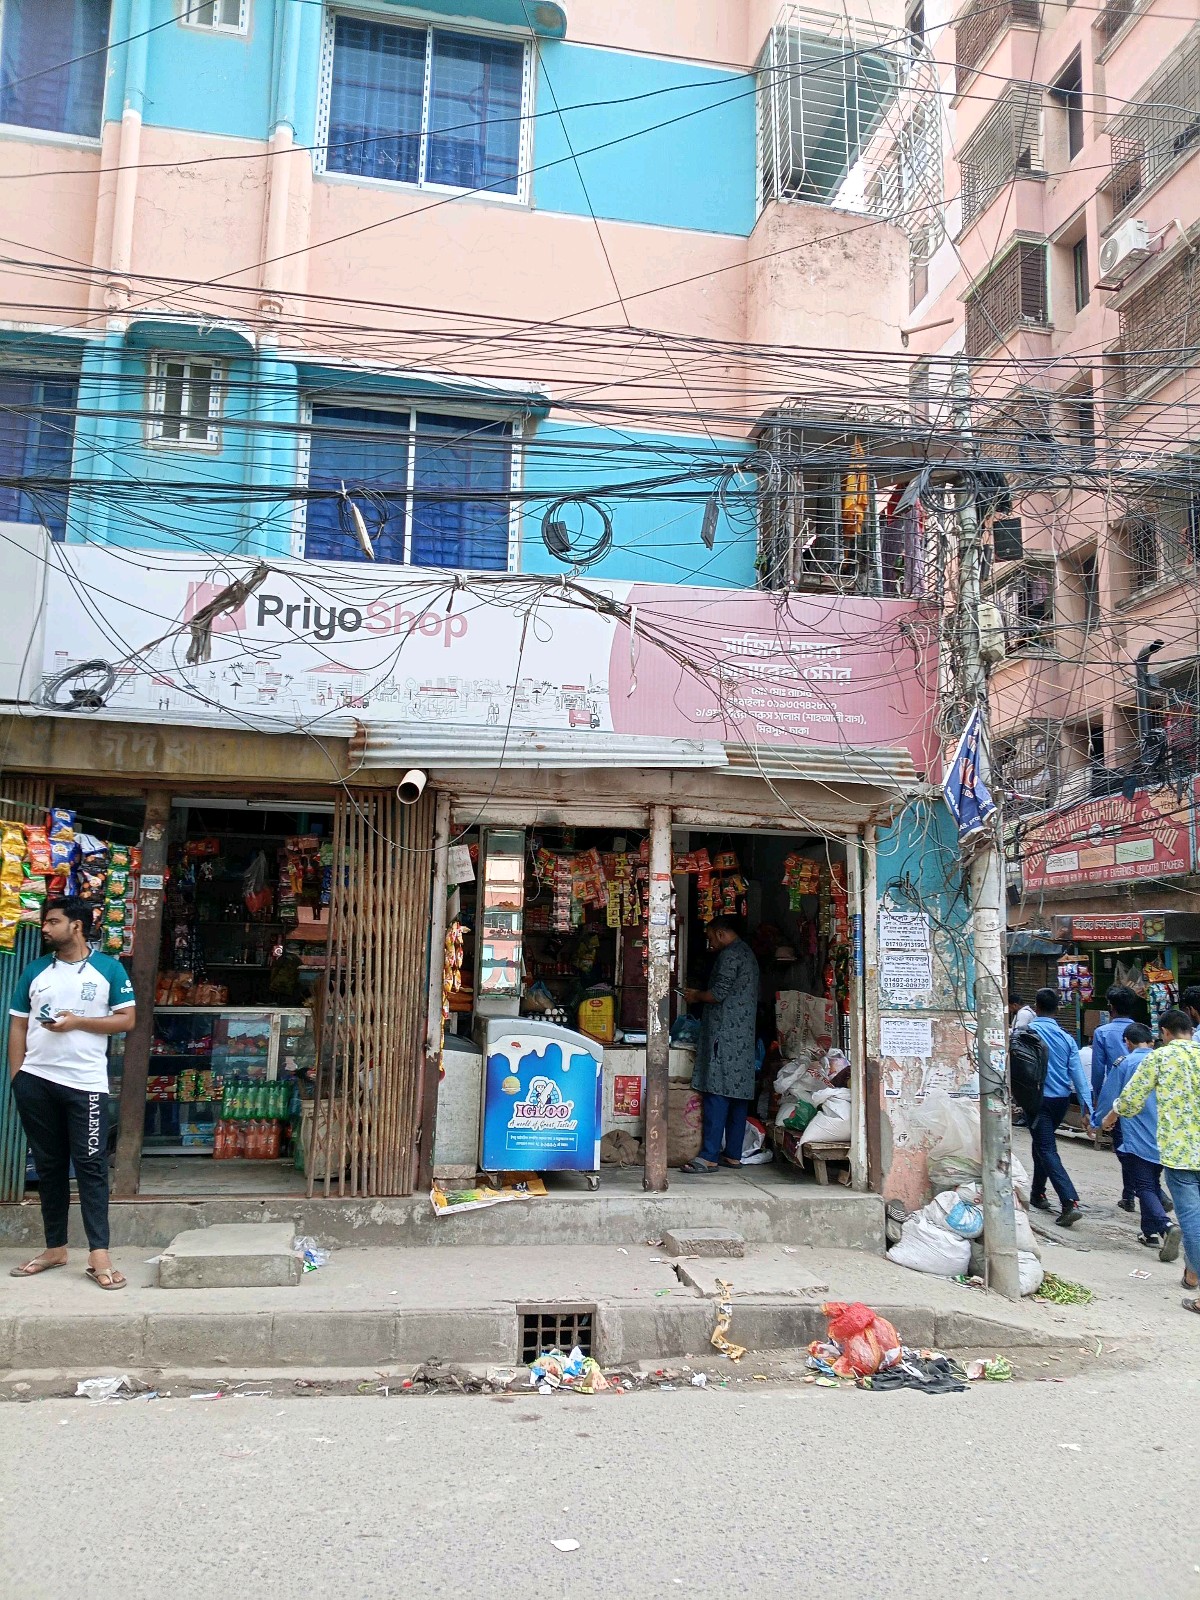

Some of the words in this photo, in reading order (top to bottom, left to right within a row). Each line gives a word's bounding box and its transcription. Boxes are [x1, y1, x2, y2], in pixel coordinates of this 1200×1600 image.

[516, 1104, 569, 1119] IGLOO
[88, 1093, 101, 1156] BALENCA
[516, 1119, 530, 1127] world
